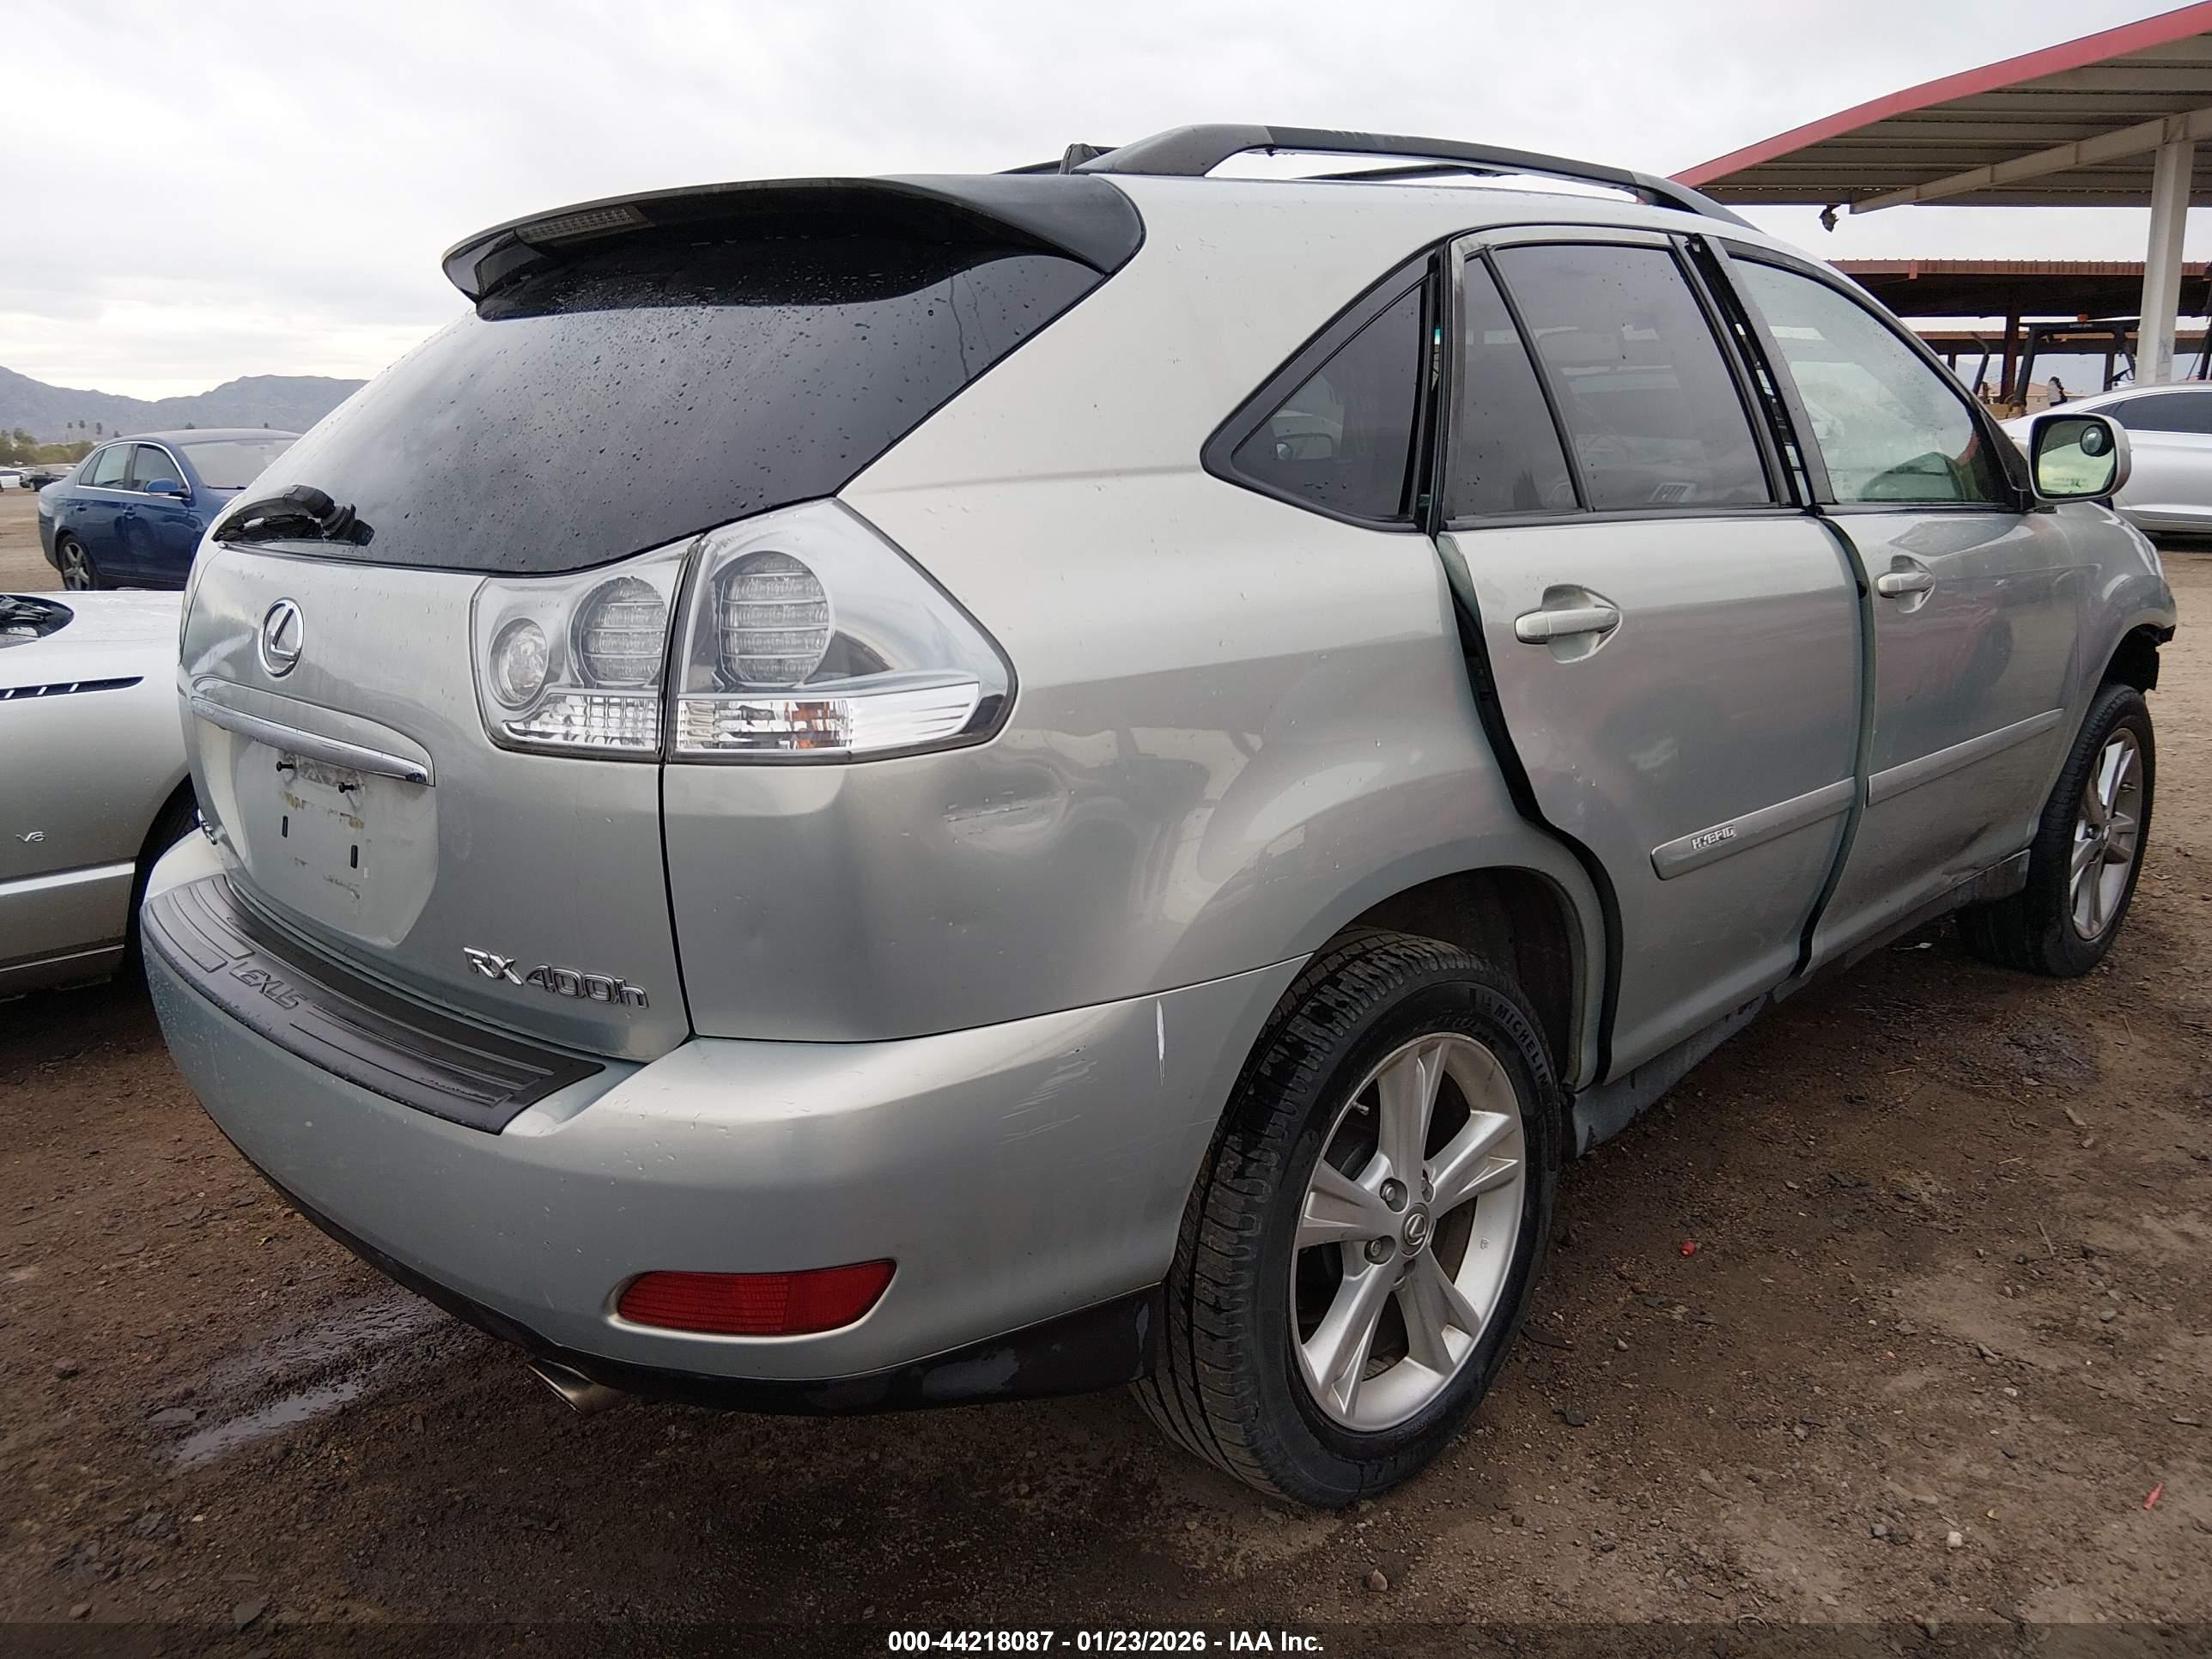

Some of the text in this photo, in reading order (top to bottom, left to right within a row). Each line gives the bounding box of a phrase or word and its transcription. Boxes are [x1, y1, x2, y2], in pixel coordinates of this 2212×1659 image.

[229, 962, 307, 1010] LEXUS
[464, 946, 649, 1009] RX 400h
[1493, 1004, 1550, 1086] MICHELIN
